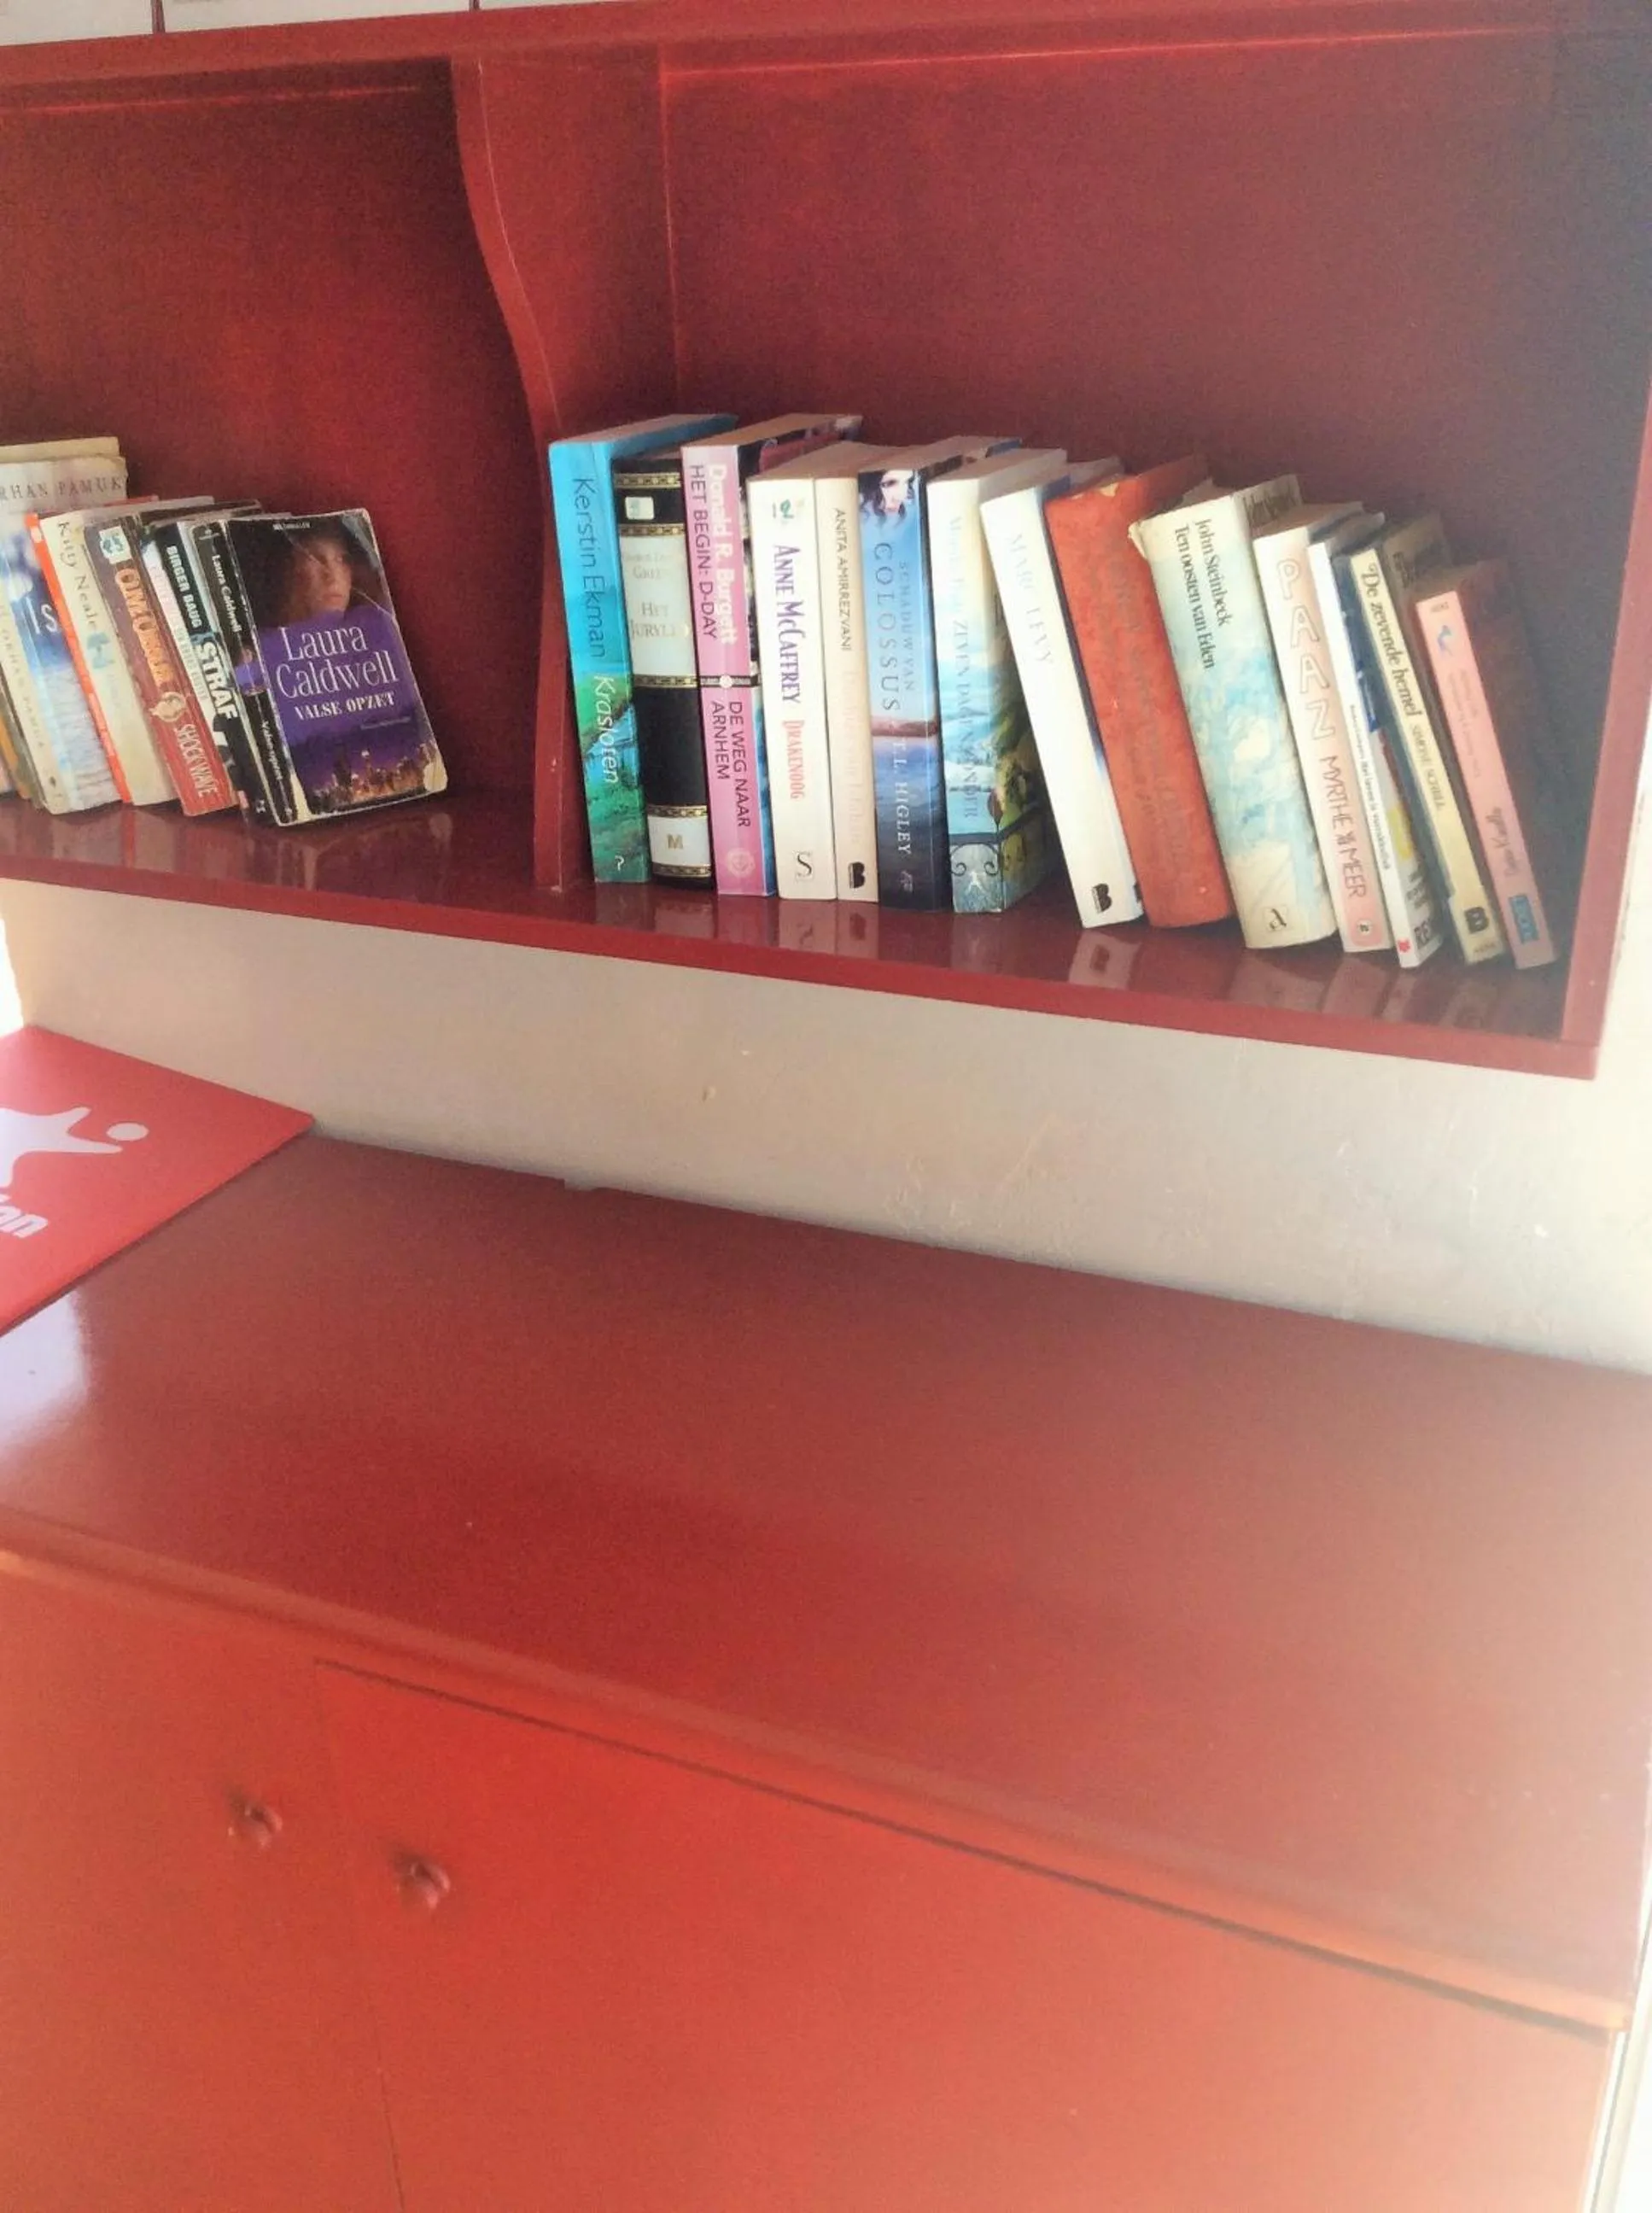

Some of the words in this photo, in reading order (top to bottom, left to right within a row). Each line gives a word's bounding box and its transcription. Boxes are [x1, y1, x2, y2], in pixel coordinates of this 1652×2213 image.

[690, 464, 707, 500] HET
[709, 464, 733, 537] Donald
[572, 478, 600, 567] Kerstin
[693, 511, 712, 575] BEGIN:
[832, 508, 847, 552] ANITA
[1175, 524, 1190, 552] Ten
[1181, 552, 1201, 603] oosten
[1194, 518, 1214, 555] John
[1205, 554, 1233, 627] Steinbeck
[1361, 562, 1381, 597] De
[582, 575, 606, 658] Ekman
[698, 581, 717, 639] D-DAY
[715, 568, 738, 645] Burgett
[837, 557, 851, 651] AMIRREZVANI
[874, 542, 901, 711] COLOSSUS
[899, 560, 914, 651] SCHADUW
[1192, 604, 1207, 632] van
[279, 625, 368, 661] Laura
[1197, 632, 1217, 669] Eden
[1276, 558, 1336, 741] PAAZ
[1370, 601, 1403, 667] zevende
[196, 641, 238, 720] STRAF
[276, 651, 400, 698] Caldwell
[903, 657, 915, 692] VAN
[1392, 668, 1423, 717] hemel
[295, 700, 342, 721] VALSE
[346, 692, 396, 713] OPZET
[729, 701, 744, 725] DE
[711, 701, 730, 780] ARNHEM
[731, 731, 746, 773] WEG
[782, 719, 805, 800] DRAKENOOG
[735, 778, 750, 827] NAAR
[895, 781, 912, 855] HIGLEY
[1320, 755, 1353, 829] MYRTHE
[1340, 847, 1366, 898] MEER
